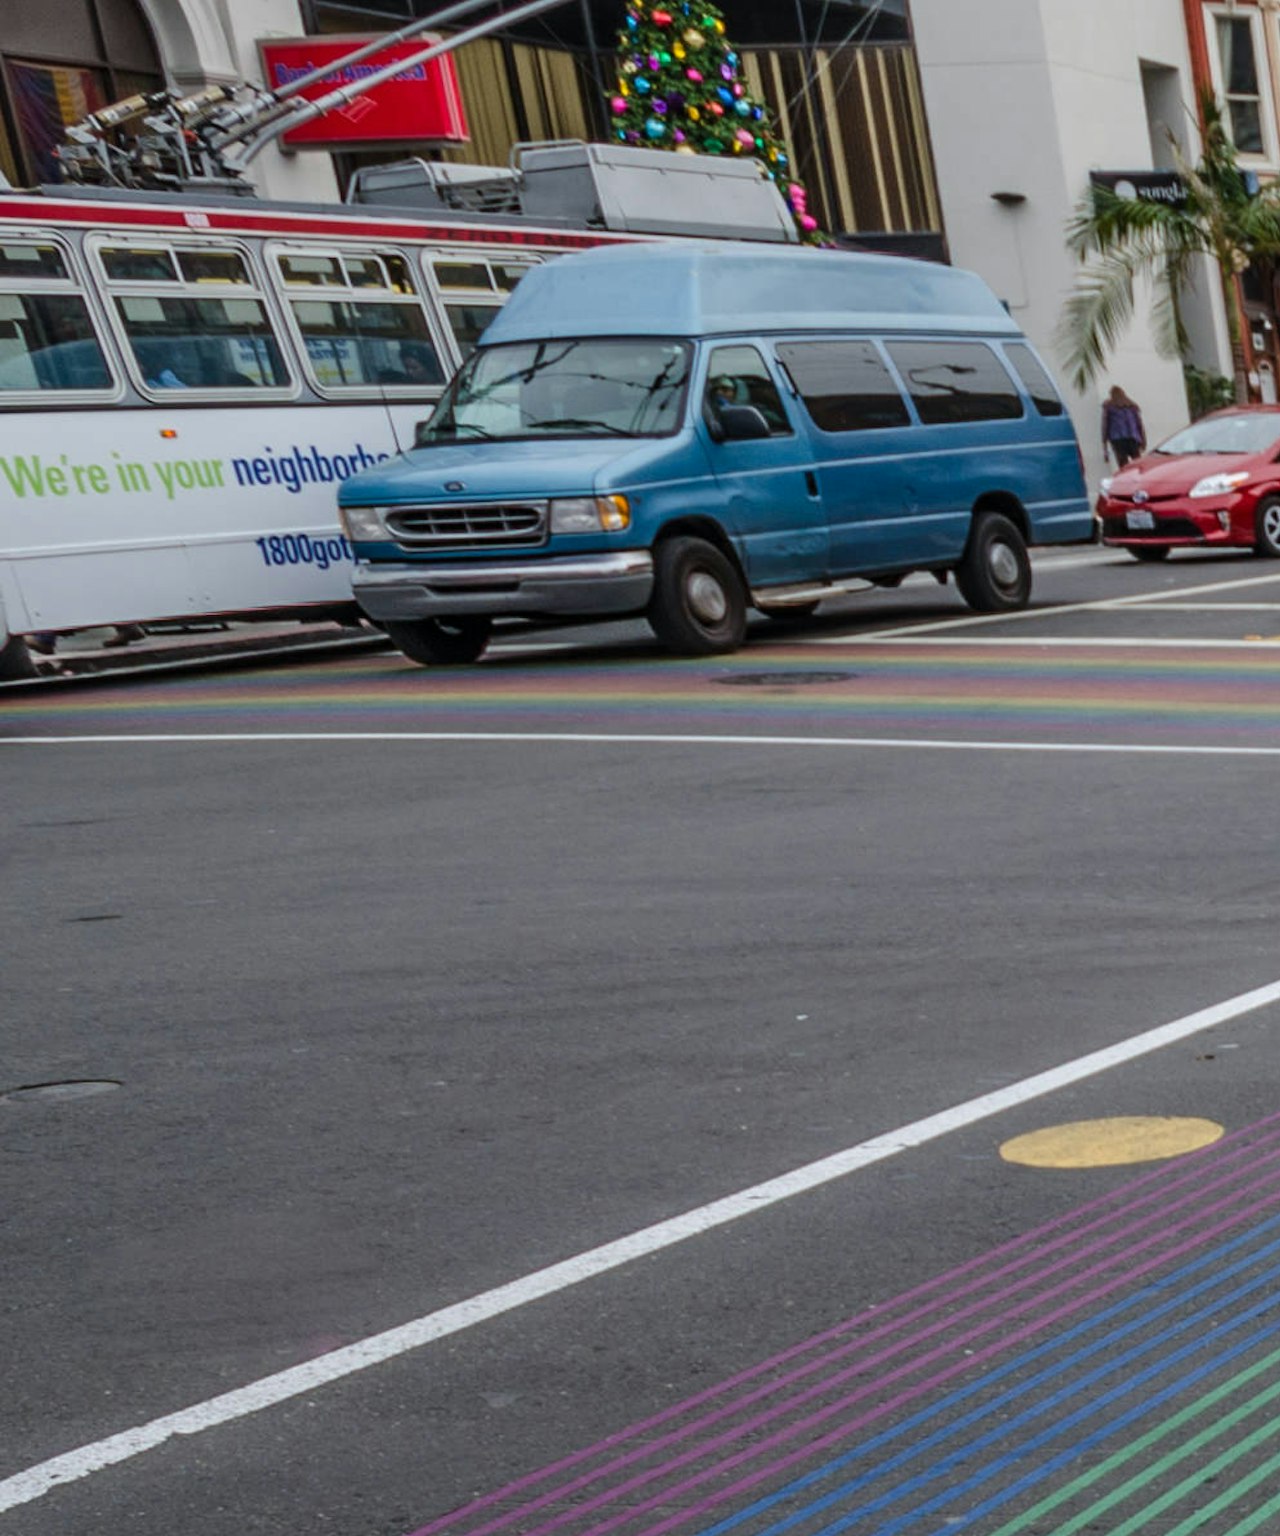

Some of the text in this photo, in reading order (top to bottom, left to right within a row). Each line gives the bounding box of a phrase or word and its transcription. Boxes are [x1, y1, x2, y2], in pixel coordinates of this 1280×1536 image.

[0, 454, 110, 498] We're
[112, 452, 151, 492] in
[153, 459, 225, 500] your
[255, 534, 361, 569] 1800got
